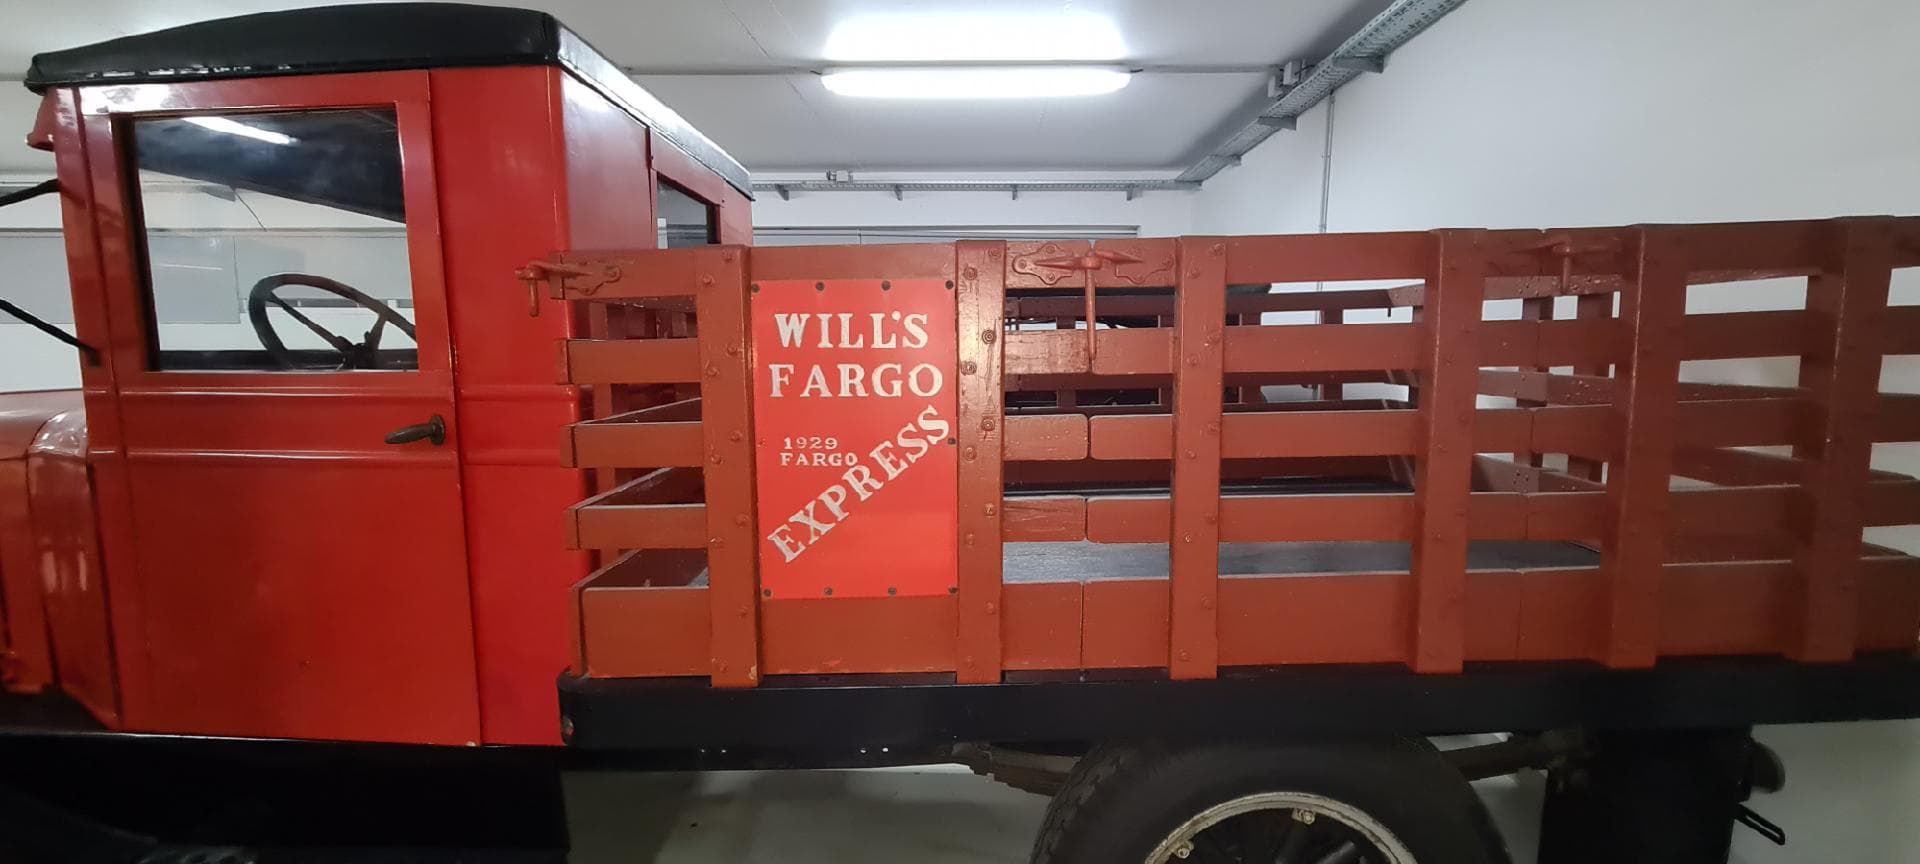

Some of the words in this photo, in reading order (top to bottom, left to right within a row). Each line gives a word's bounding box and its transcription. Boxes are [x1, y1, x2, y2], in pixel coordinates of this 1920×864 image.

[774, 310, 929, 349] WILL'S
[768, 363, 944, 398] FARGO
[779, 452, 859, 467] FARGO
[783, 436, 839, 450] 1929
[767, 404, 951, 563] EXPRESS
